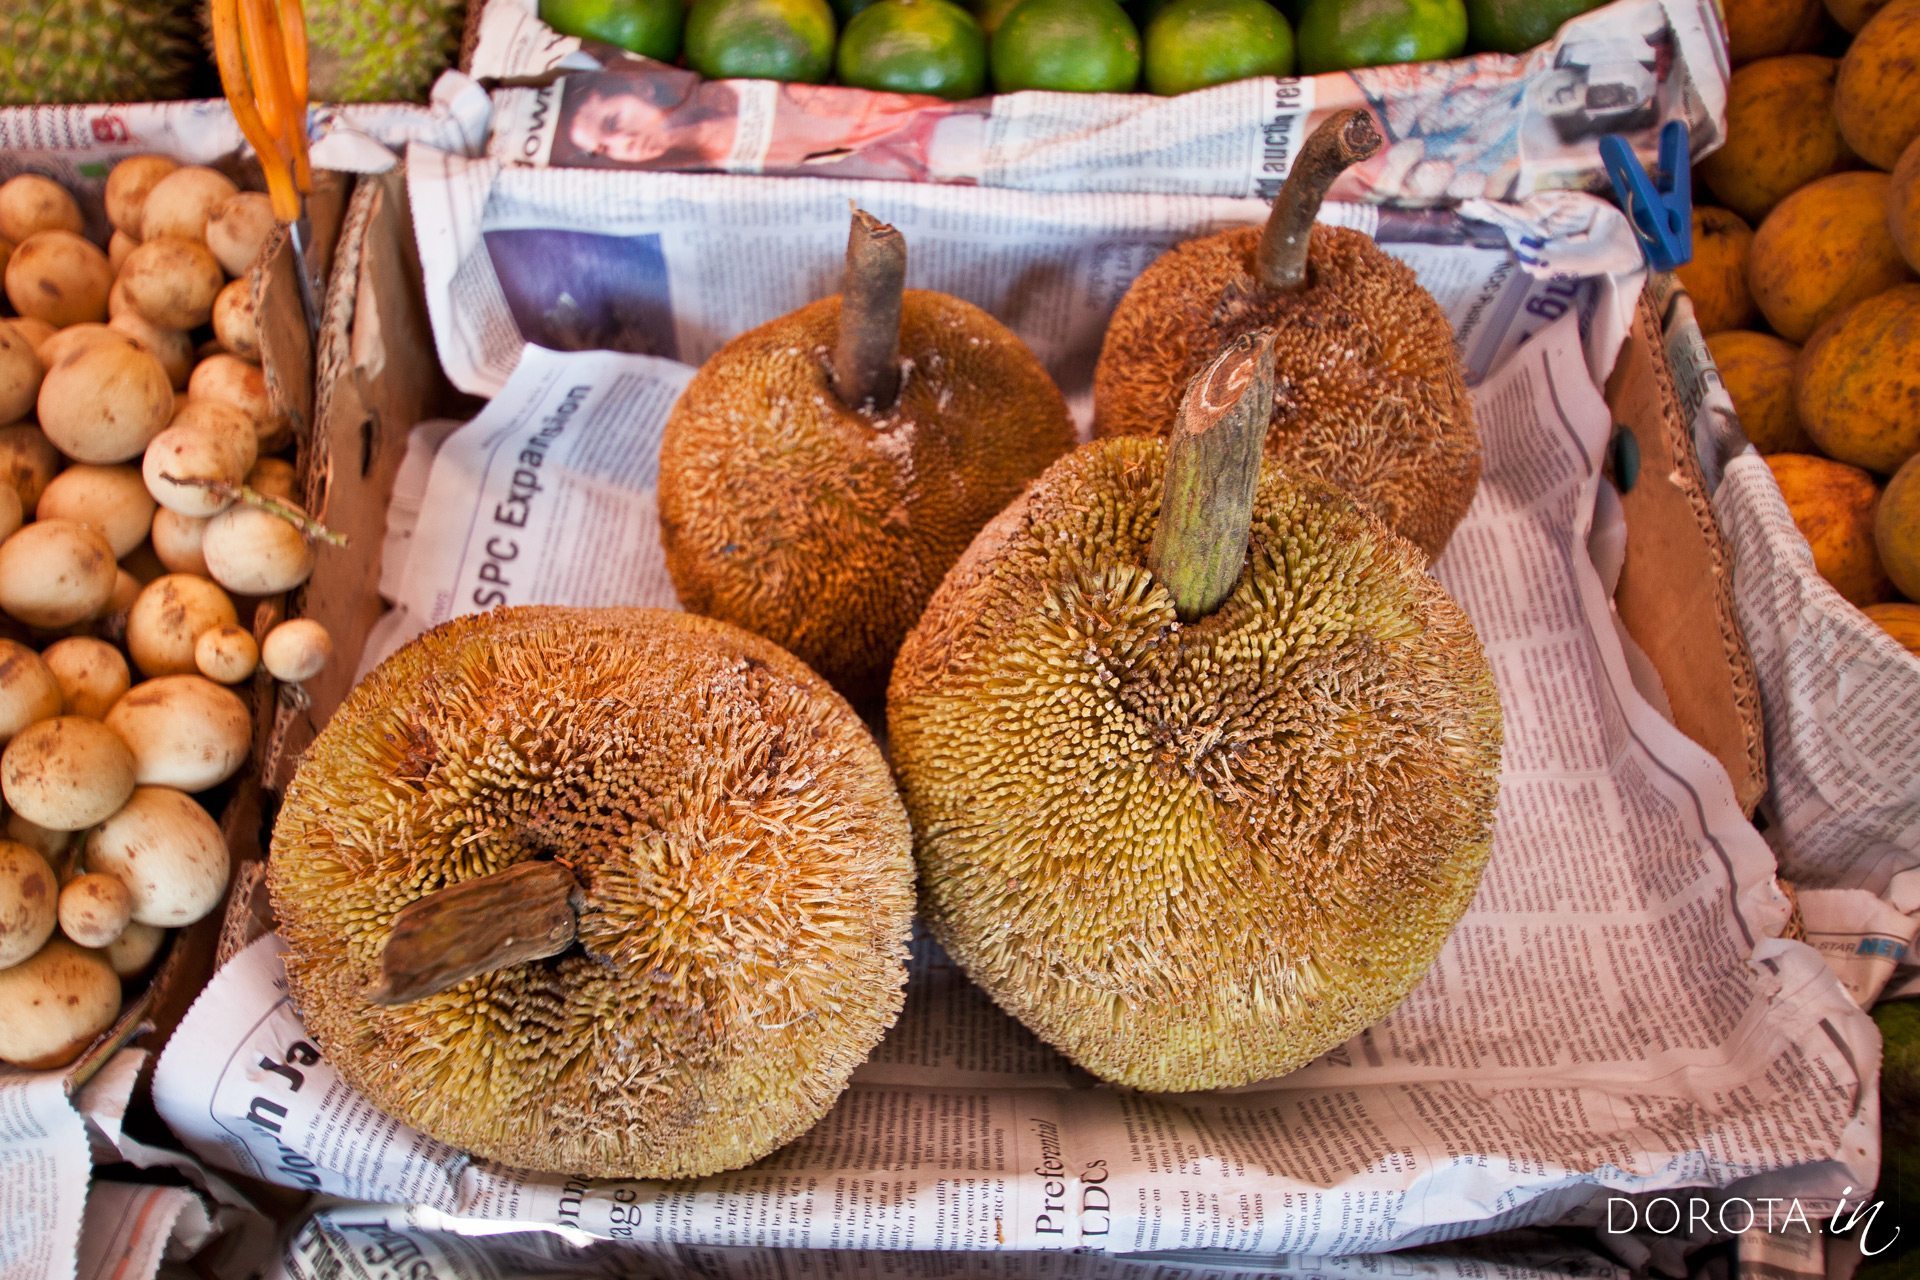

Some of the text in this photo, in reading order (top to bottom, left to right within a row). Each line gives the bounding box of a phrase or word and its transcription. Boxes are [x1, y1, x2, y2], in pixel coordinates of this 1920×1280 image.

[473, 385, 592, 607] SPC Expansion
[258, 1040, 322, 1093] Ja
[354, 1107, 375, 1134] Aside
[1162, 1149, 1173, 1173] efforts
[1192, 1162, 1201, 1176] for
[881, 1182, 889, 1191] an
[953, 1178, 960, 1188] as
[996, 1179, 1004, 1193] for
[1029, 1118, 1065, 1236] Preferential
[791, 1189, 800, 1197] of
[834, 1178, 844, 1220] signature
[863, 1179, 875, 1229] report will
[894, 1181, 903, 1219] requests
[908, 1181, 917, 1209] of the
[937, 1178, 947, 1205] utility
[965, 1178, 975, 1225] executed
[1080, 1160, 1110, 1236] LDCs
[1153, 1189, 1161, 1201] on
[1196, 1192, 1206, 1215] they
[1210, 1193, 1218, 1202] is
[1283, 1193, 1292, 1208] for
[1299, 1193, 1307, 1213] and
[1370, 1191, 1380, 1213] This
[510, 1199, 519, 1218] with
[656, 1193, 668, 1222] entity
[728, 1200, 739, 1225] ERC
[758, 1209, 767, 1226] law
[789, 1202, 798, 1223] part
[805, 1199, 813, 1227] to the
[848, 1209, 856, 1225] the
[878, 1194, 887, 1218] when
[980, 1178, 989, 1243] the law who
[995, 1196, 1004, 1221] ERC
[1134, 1188, 1148, 1248] committee on
[1180, 1190, 1191, 1241] submitted
[1239, 1194, 1249, 1226] origin
[1313, 1193, 1322, 1230] of these
[1342, 1192, 1351, 1230] compile
[1354, 1192, 1365, 1233] and take
[773, 1214, 781, 1225] be
